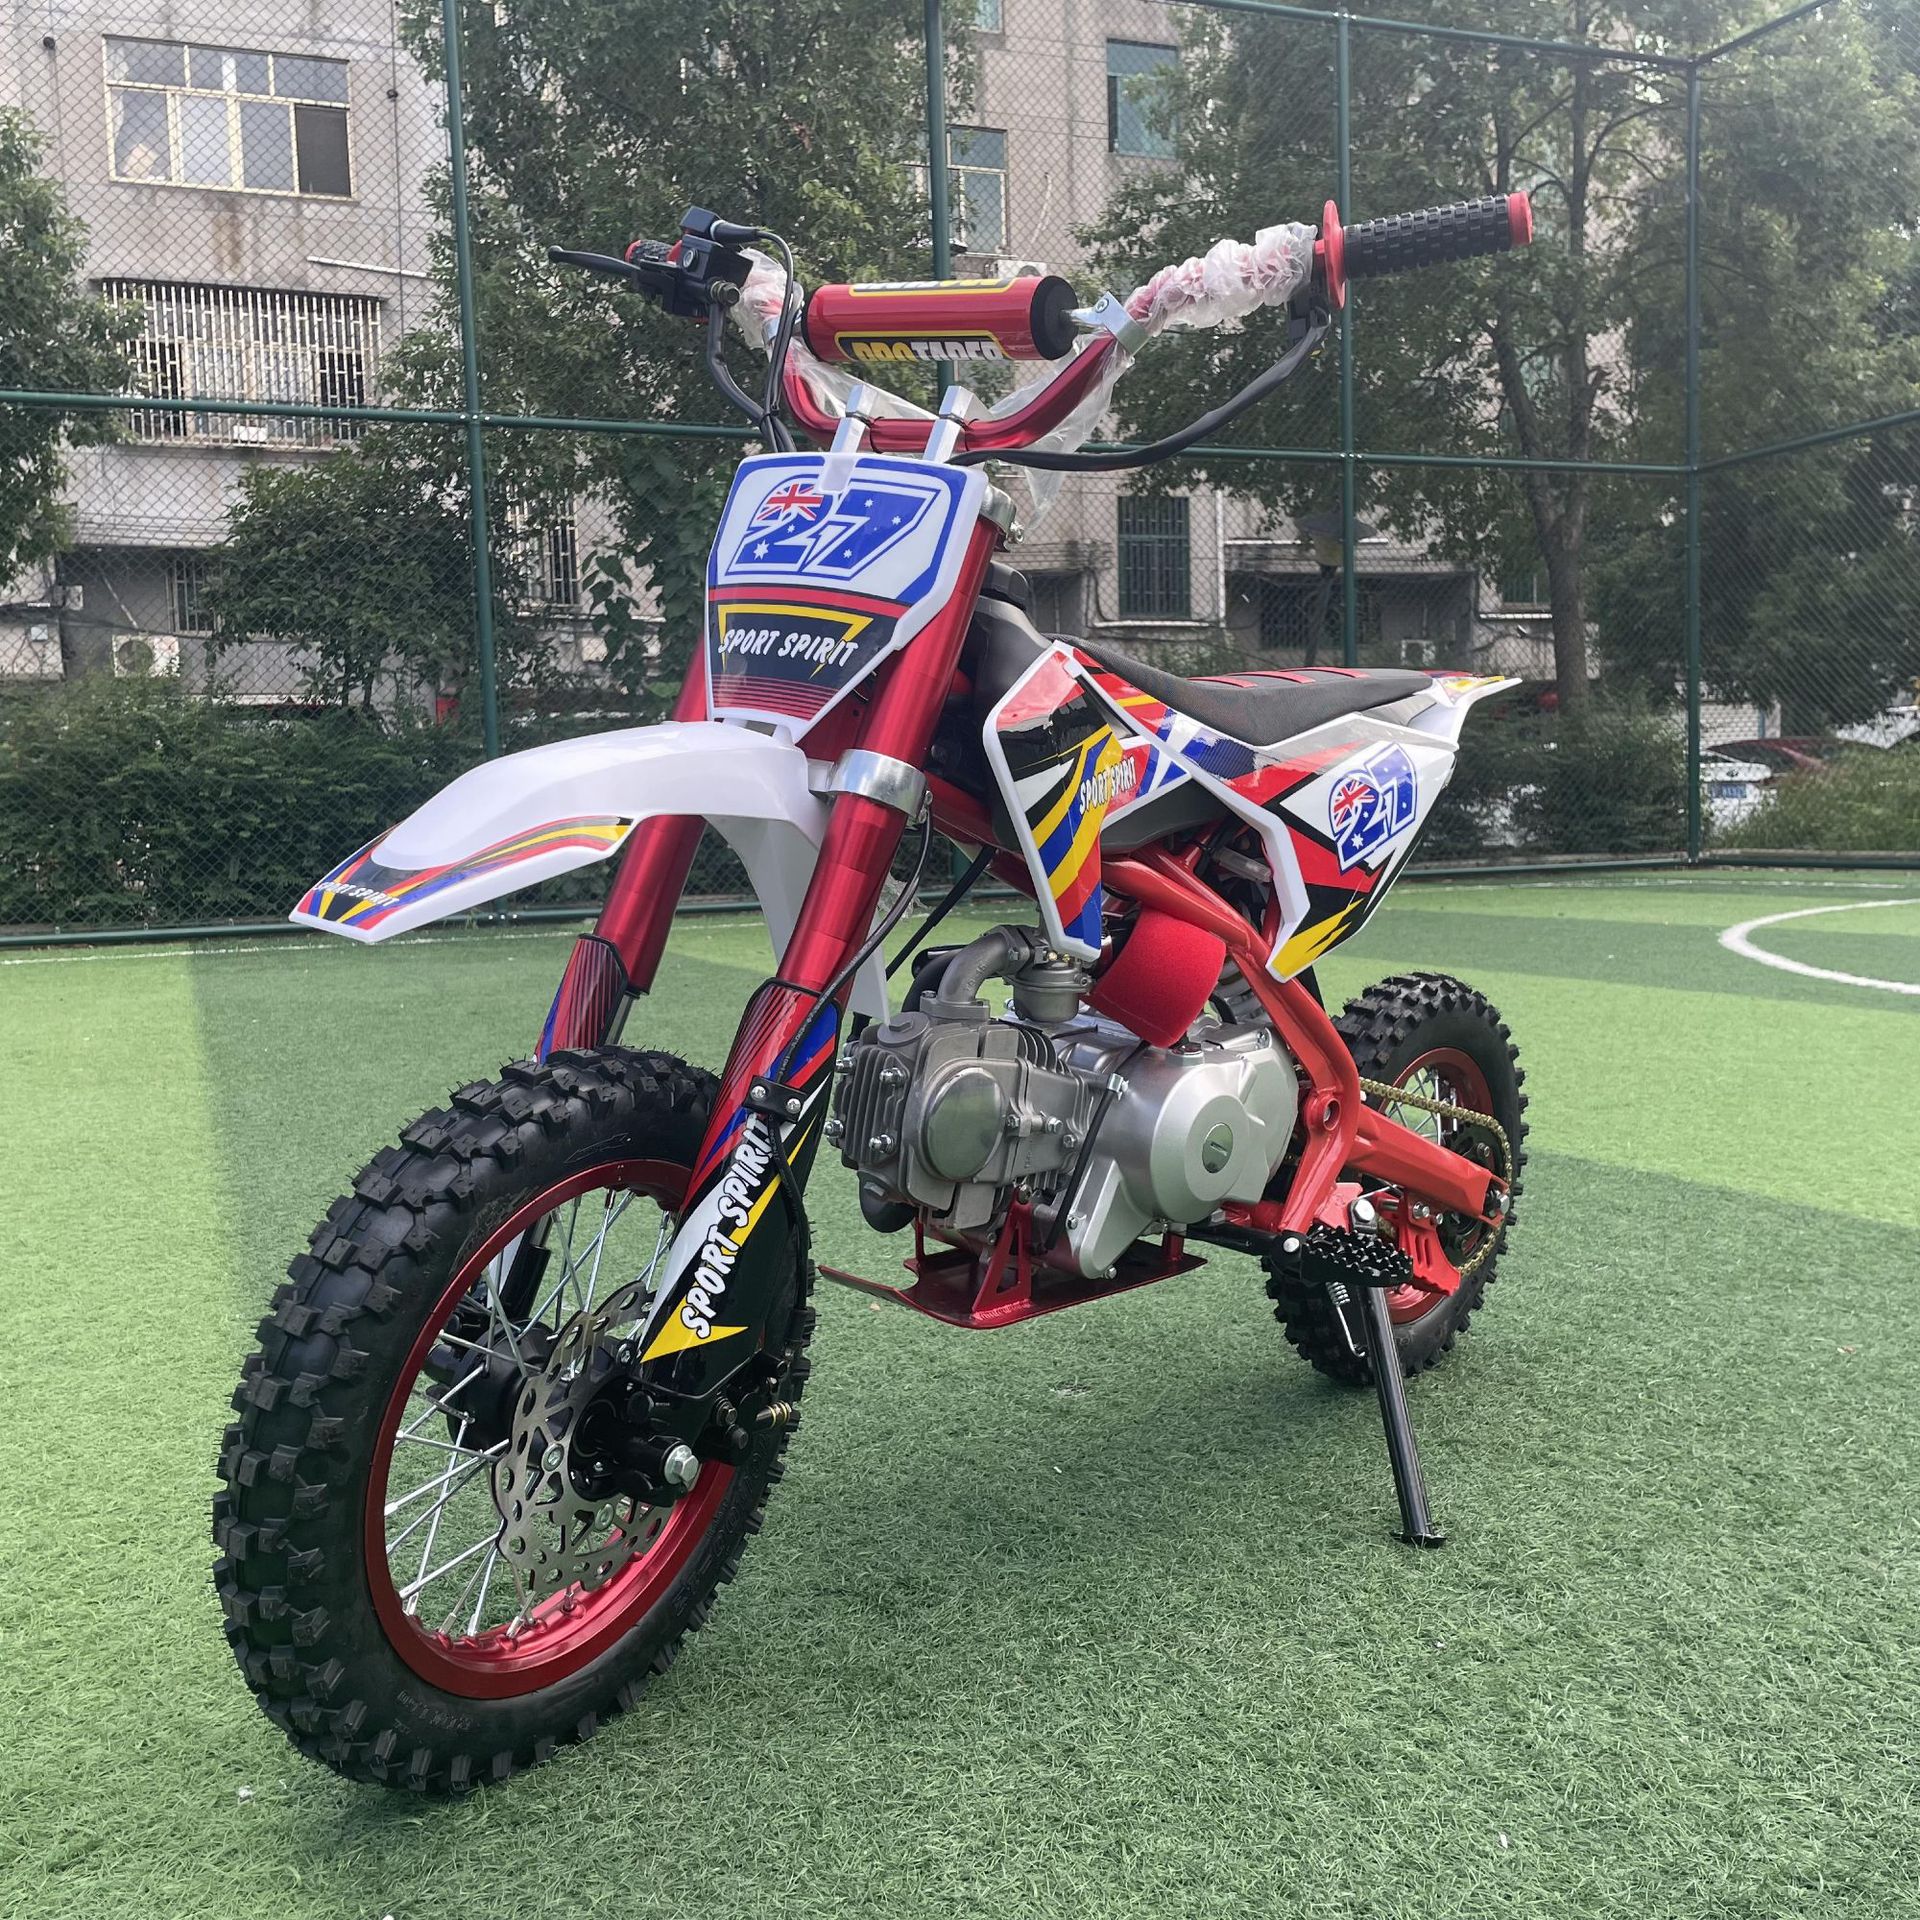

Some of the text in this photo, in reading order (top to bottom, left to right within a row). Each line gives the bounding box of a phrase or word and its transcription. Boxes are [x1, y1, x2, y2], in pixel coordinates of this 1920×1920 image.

[725, 474, 941, 581] 27
[718, 629, 859, 667] SPORT SPIRIT
[1079, 757, 1137, 815] SPORT SPIRIT
[1329, 742, 1417, 874] 27
[313, 881, 400, 907] SPORT SPIRIT
[681, 1112, 773, 1339] SPORT SPIRIT
